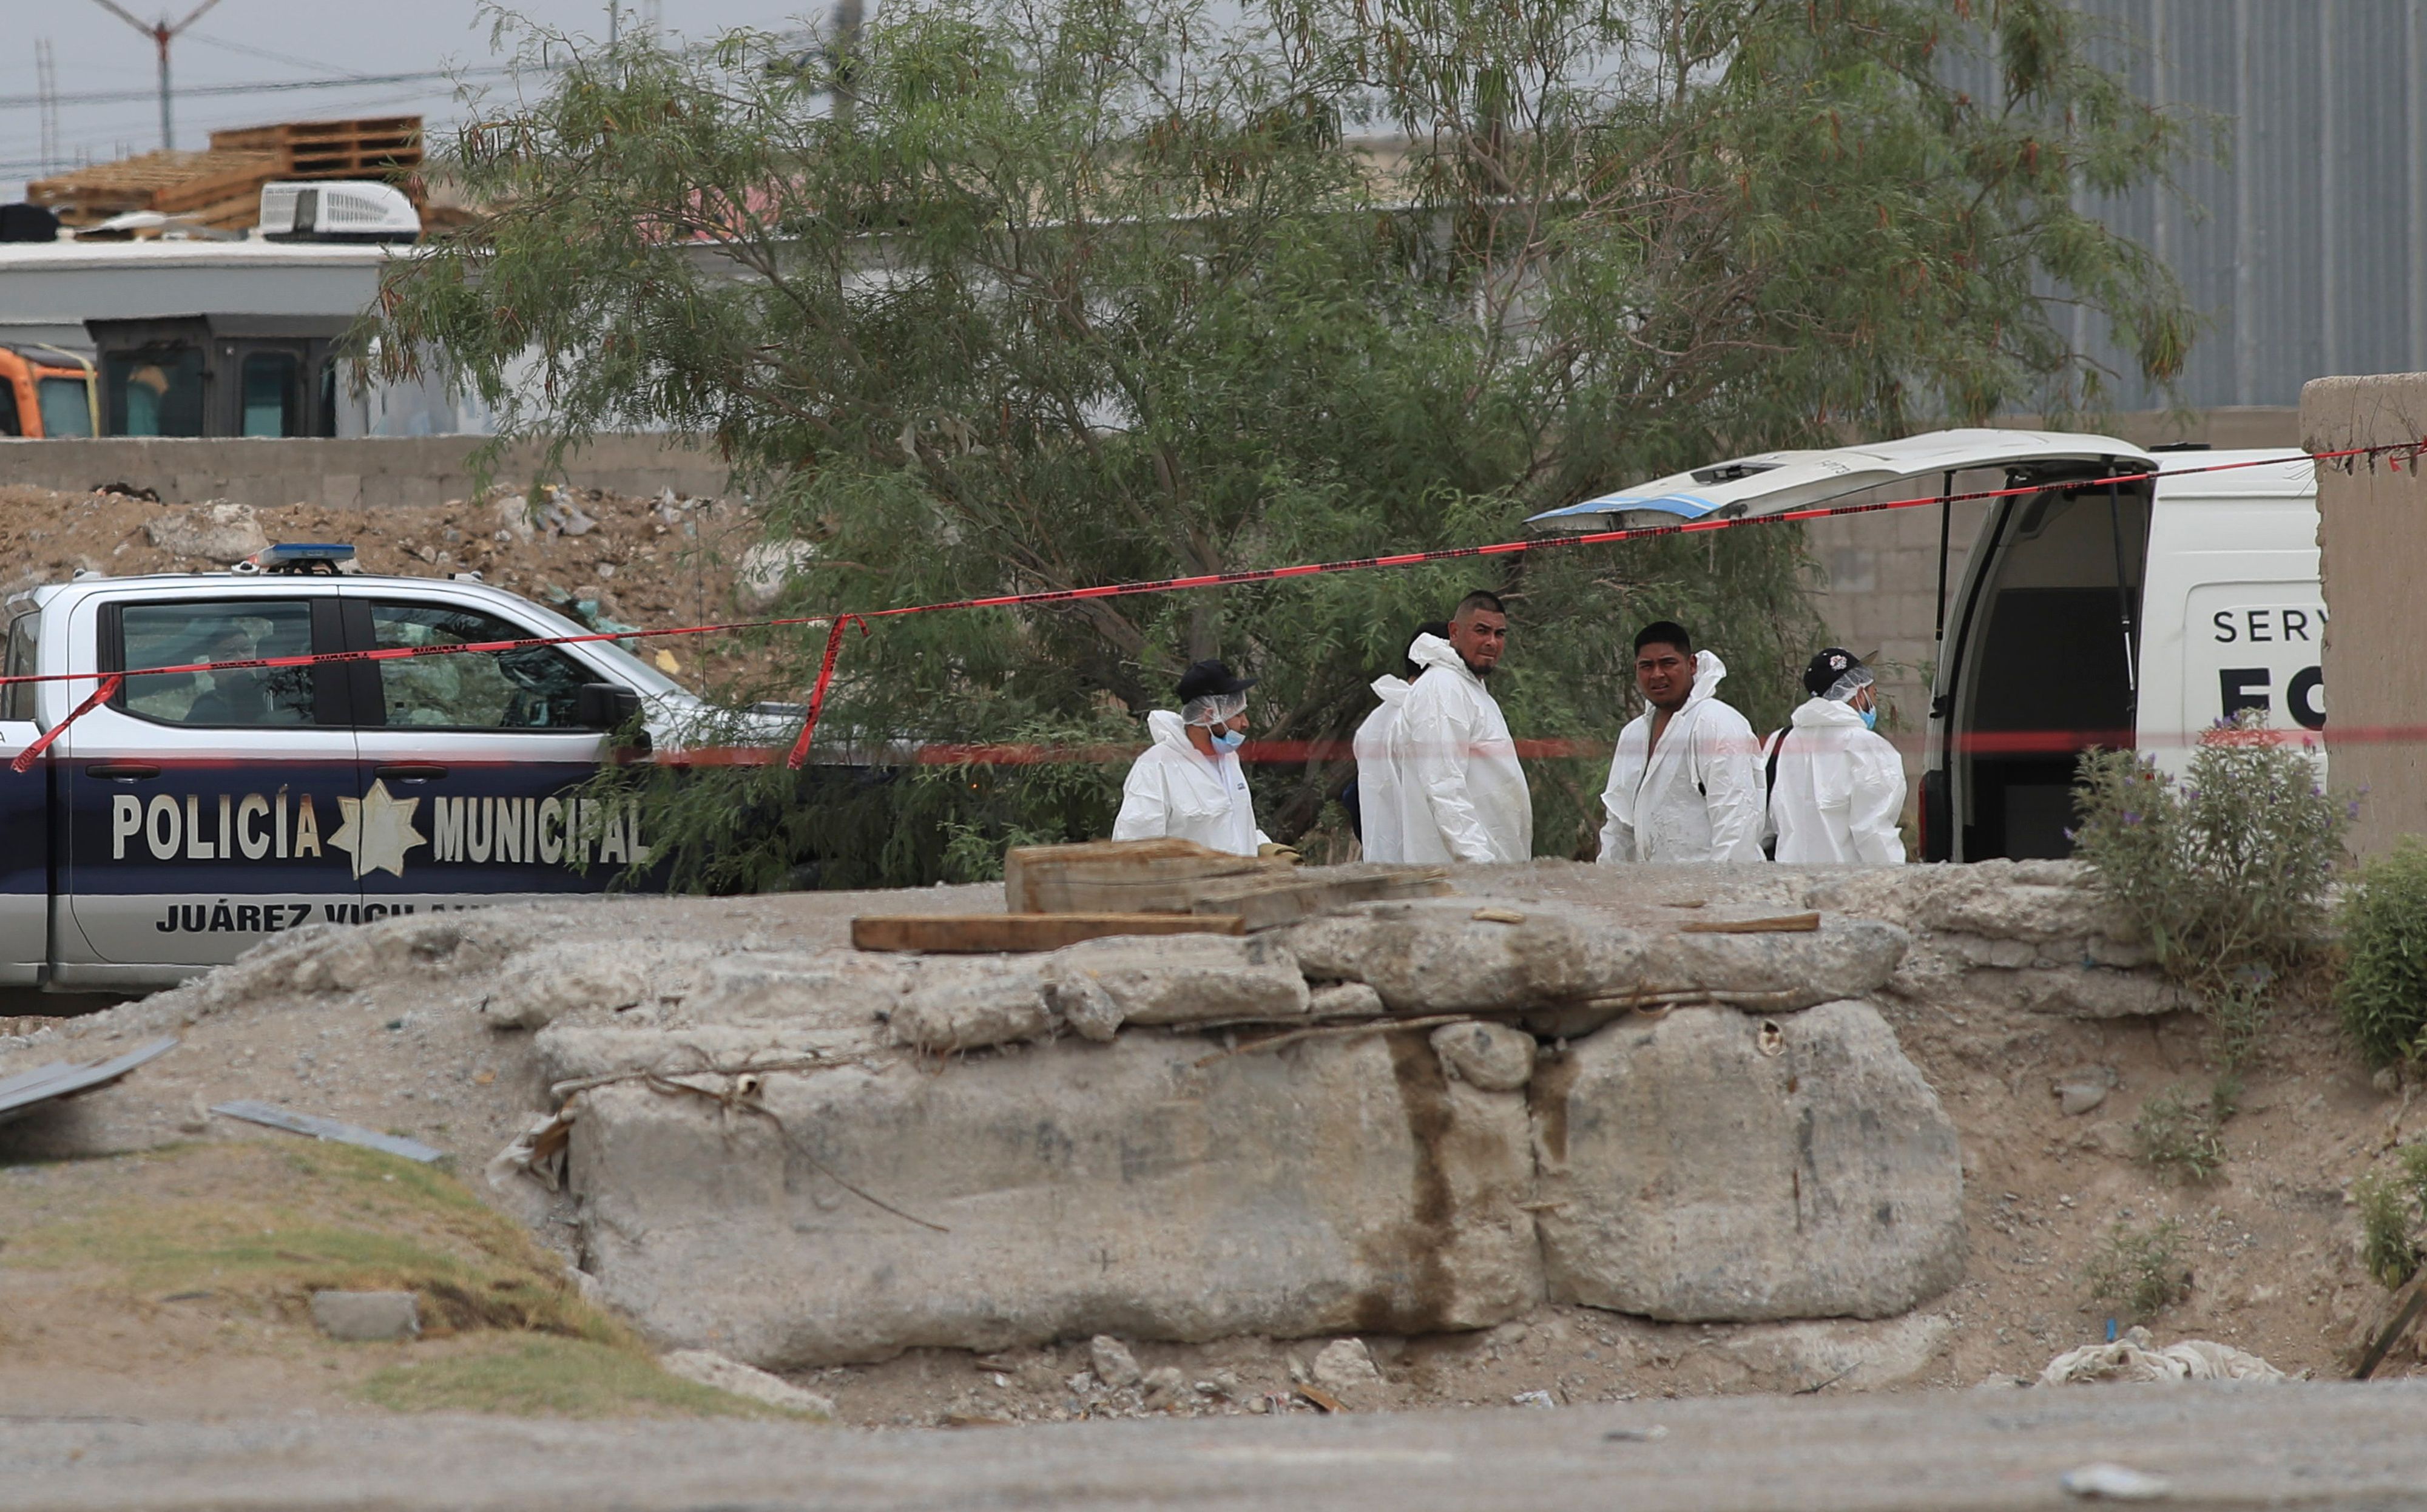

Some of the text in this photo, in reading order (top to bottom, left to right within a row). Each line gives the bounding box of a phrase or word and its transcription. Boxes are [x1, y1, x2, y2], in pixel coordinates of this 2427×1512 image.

[113, 783, 650, 863] POLICÍA MUNICIPAL
[157, 899, 312, 933] JUÁREZ
